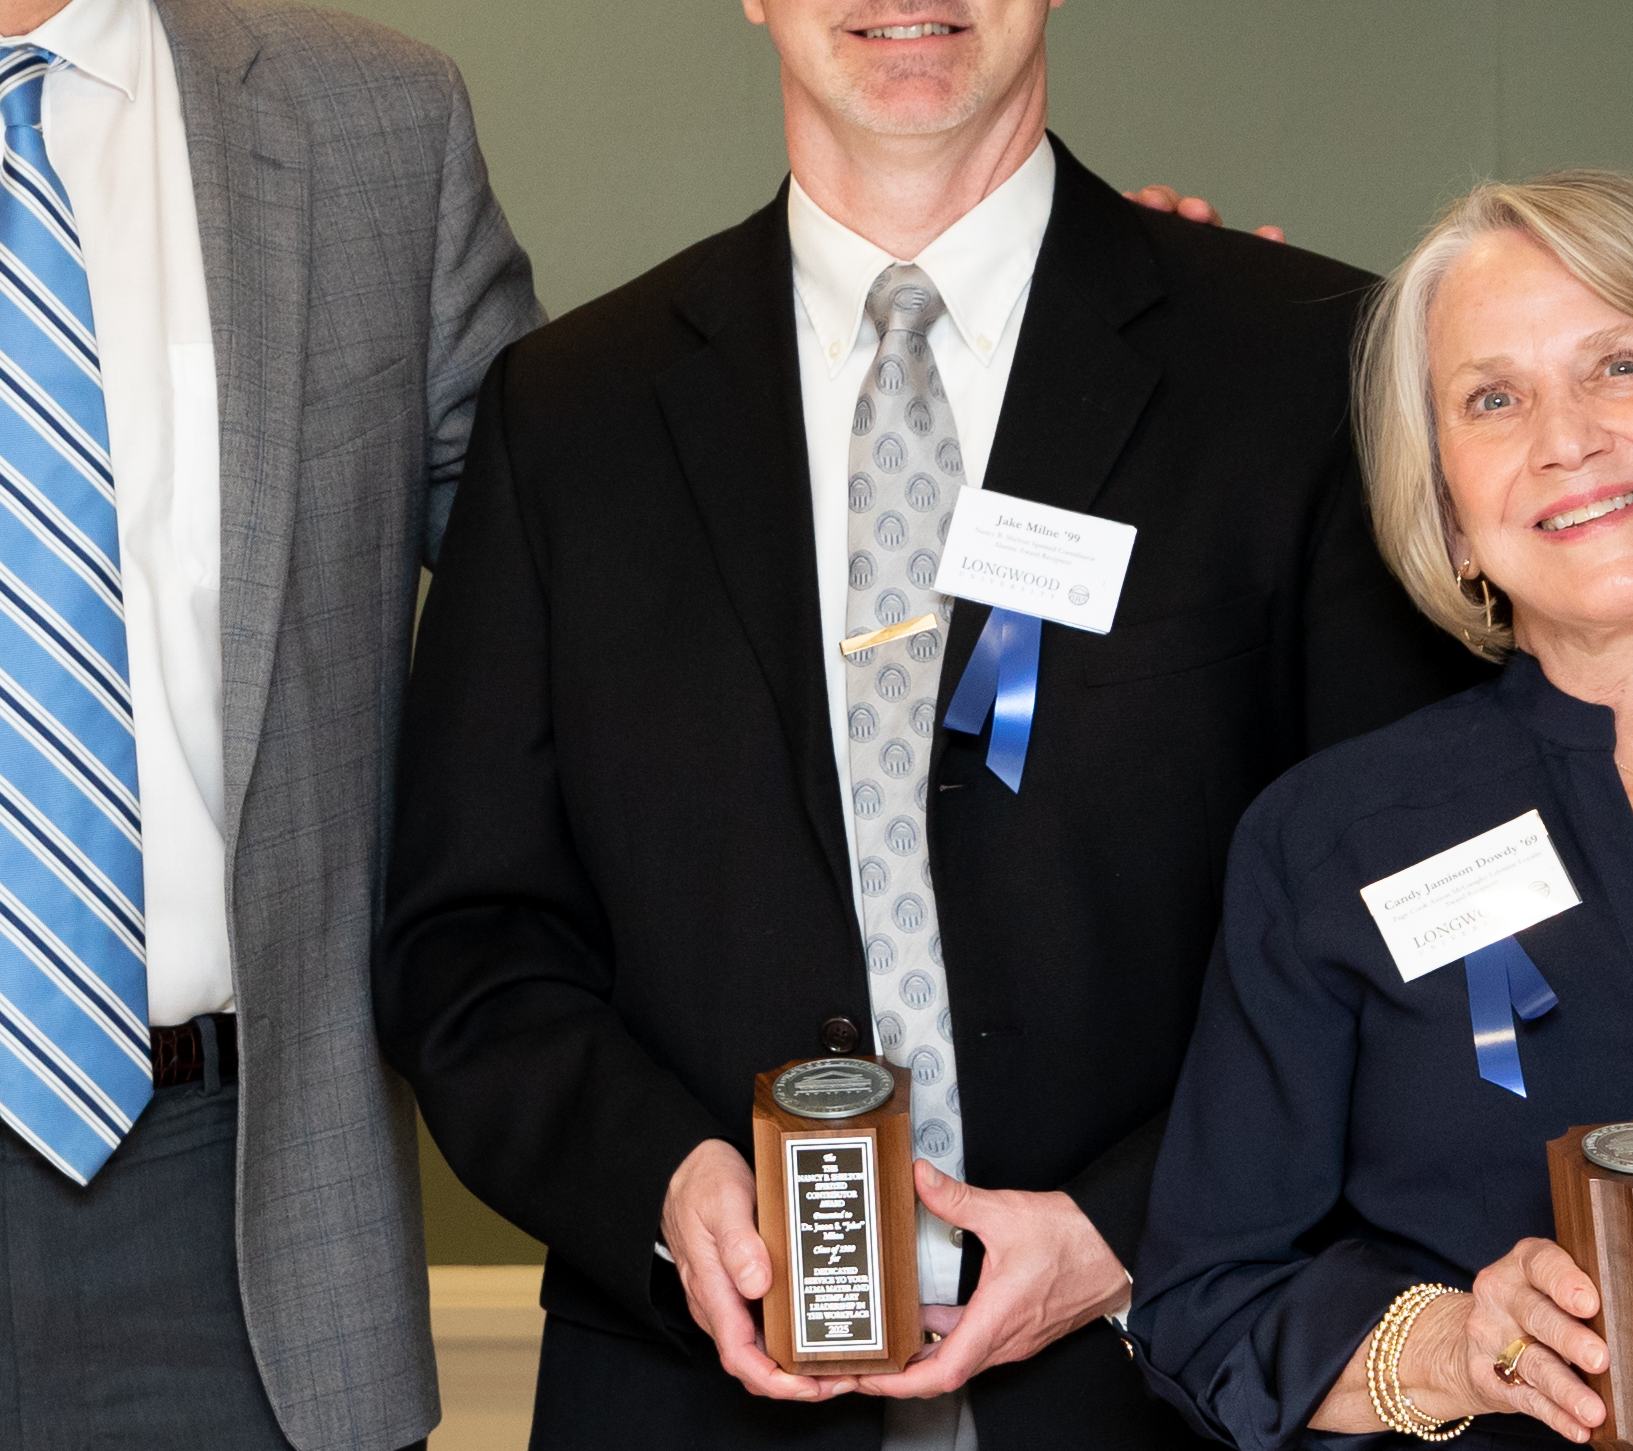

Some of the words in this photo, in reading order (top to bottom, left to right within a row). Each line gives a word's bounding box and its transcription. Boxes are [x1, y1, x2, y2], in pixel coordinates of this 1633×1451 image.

[996, 515, 1022, 529] Jake
[1026, 522, 1059, 538] Milne
[1064, 531, 1081, 543] '99
[959, 570, 1055, 599] UNIVERSITY
[962, 556, 1060, 591] LONGWOOD
[1384, 889, 1422, 910] Candy
[1424, 865, 1474, 895] Jamison
[1474, 845, 1518, 869] Dowdy
[1519, 834, 1538, 847] '69
